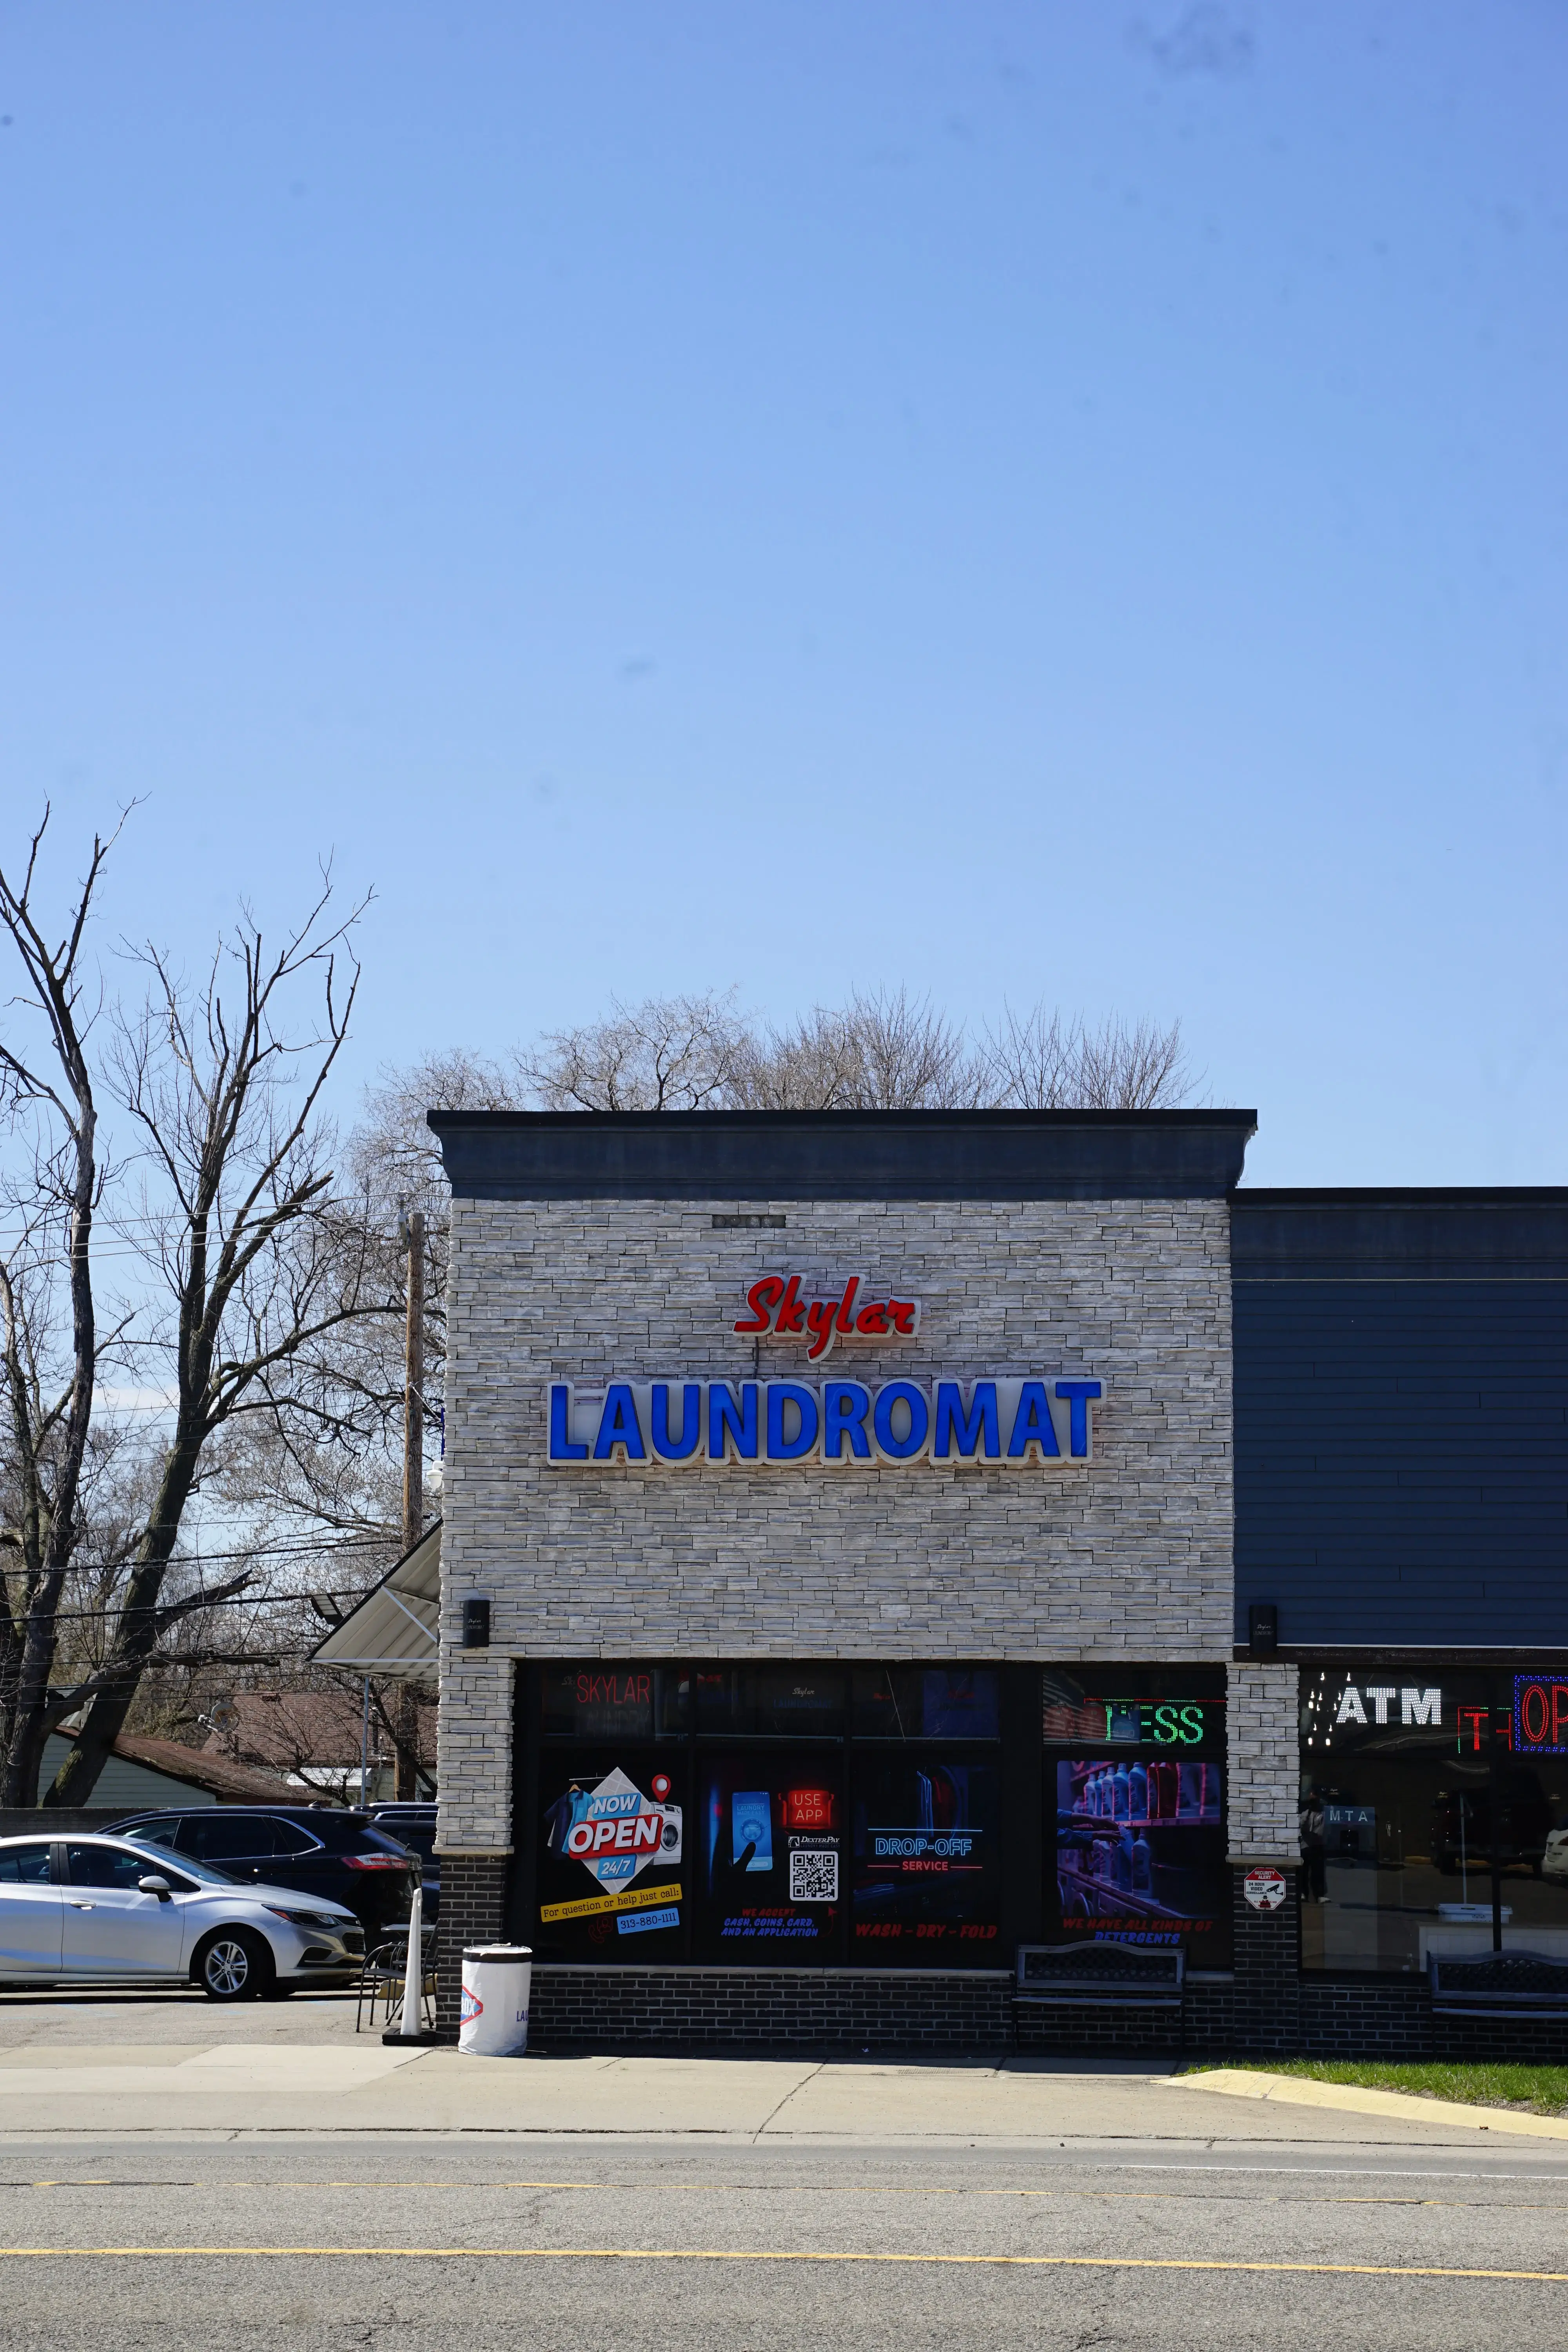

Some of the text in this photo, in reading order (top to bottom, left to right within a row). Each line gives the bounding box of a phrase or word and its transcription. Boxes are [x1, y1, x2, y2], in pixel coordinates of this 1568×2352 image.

[734, 1276, 916, 1359] Skylar
[549, 1381, 1102, 1460] LAUNDROMAT
[576, 1675, 650, 1704] SKYLAR
[792, 1687, 815, 1697] Skylar
[1336, 1687, 1441, 1724] ATM
[594, 1795, 637, 1814] NOW
[794, 1794, 821, 1806] USE
[795, 1809, 823, 1821] APP
[568, 1817, 659, 1853] OPEN
[875, 1838, 972, 1856] DROP-OFF
[601, 1859, 631, 1875] 24/7
[902, 1861, 949, 1871] SERVICE
[543, 1909, 559, 1917] For
[563, 1902, 601, 1914] question
[617, 1895, 637, 1905] help
[639, 1891, 657, 1904] just
[661, 1887, 679, 1898] call:
[742, 1908, 796, 1916] WE ACCEPT
[621, 1912, 676, 1929] 313-880-1111
[724, 1918, 815, 1928] CASH, COINS, CARD,
[1063, 1918, 1214, 1931] WE HAVE ALL KINDS OF
[721, 1927, 818, 1936] AND AN APPLICATION
[856, 1923, 902, 1937] WASH
[916, 1924, 947, 1938] DRY
[960, 1925, 997, 1939] FOLD
[1094, 1932, 1180, 1944] DETERGENTS
